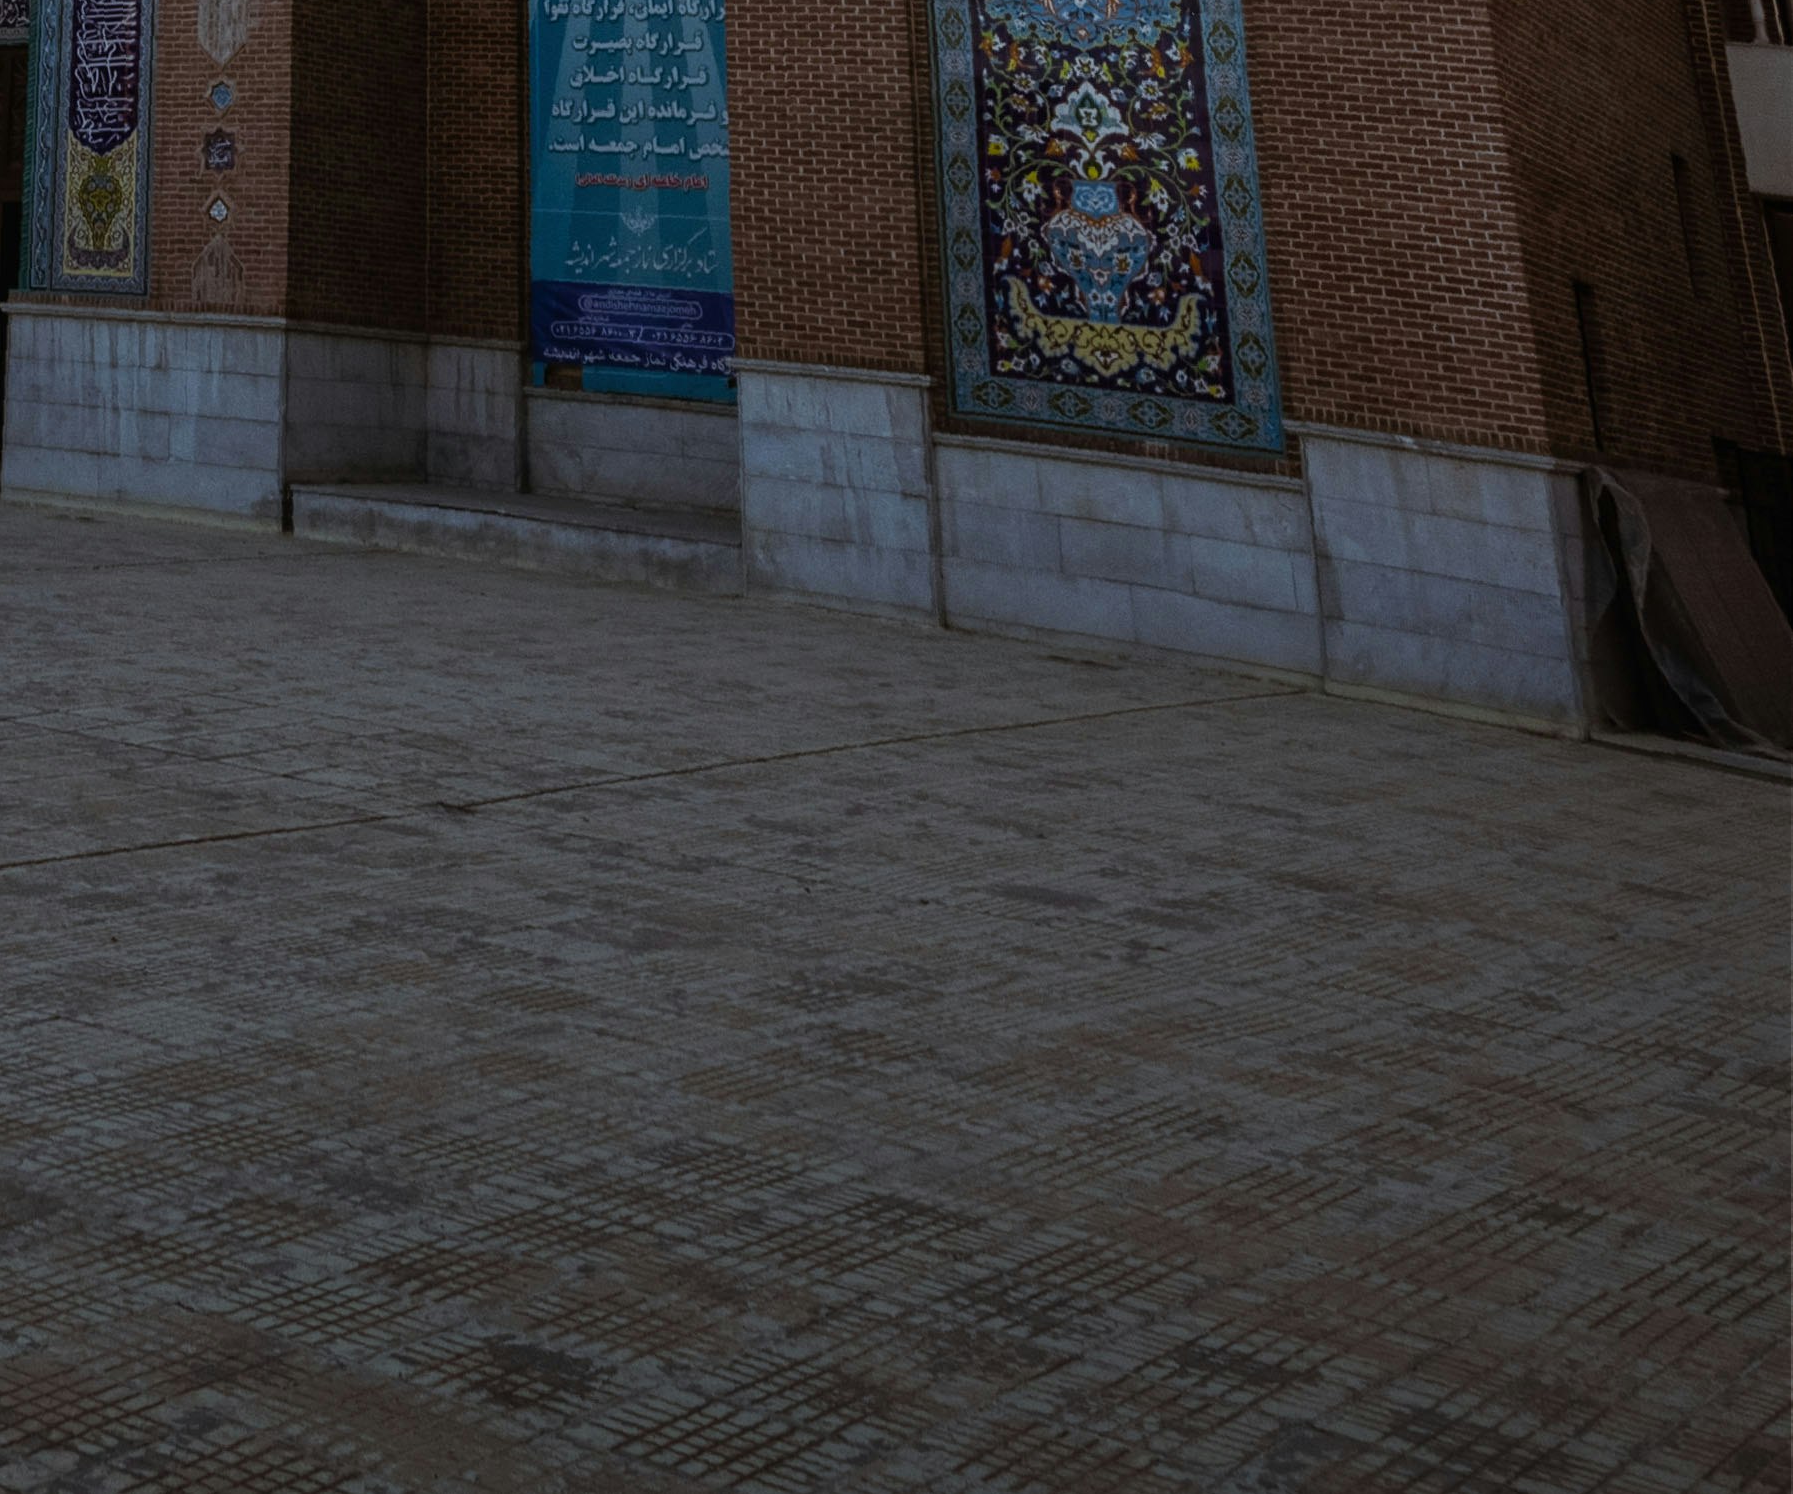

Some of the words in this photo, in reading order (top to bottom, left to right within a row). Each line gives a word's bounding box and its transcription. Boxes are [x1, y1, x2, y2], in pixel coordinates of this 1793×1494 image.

[544, 0, 570, 23] تقوا
[573, 35, 633, 56] بصیرت
[636, 30, 704, 56] قرارگاه
[570, 65, 625, 88] اخلاق
[628, 66, 707, 91] قرارگاه
[552, 98, 616, 124] قرارگاه
[619, 99, 645, 125] این
[648, 99, 717, 126] فرمانده
[589, 137, 639, 159] جمعه
[643, 136, 686, 159] امام
[682, 172, 709, 192] امام
[565, 240, 595, 275] اندیشه
[591, 235, 618, 270] شهر
[653, 226, 707, 278] برگزاری
[543, 346, 581, 362] اندیشه
[583, 348, 606, 365] شهر
[608, 350, 641, 366] جمعه
[644, 352, 666, 368] نماز
[670, 351, 708, 374] فرهنگی
